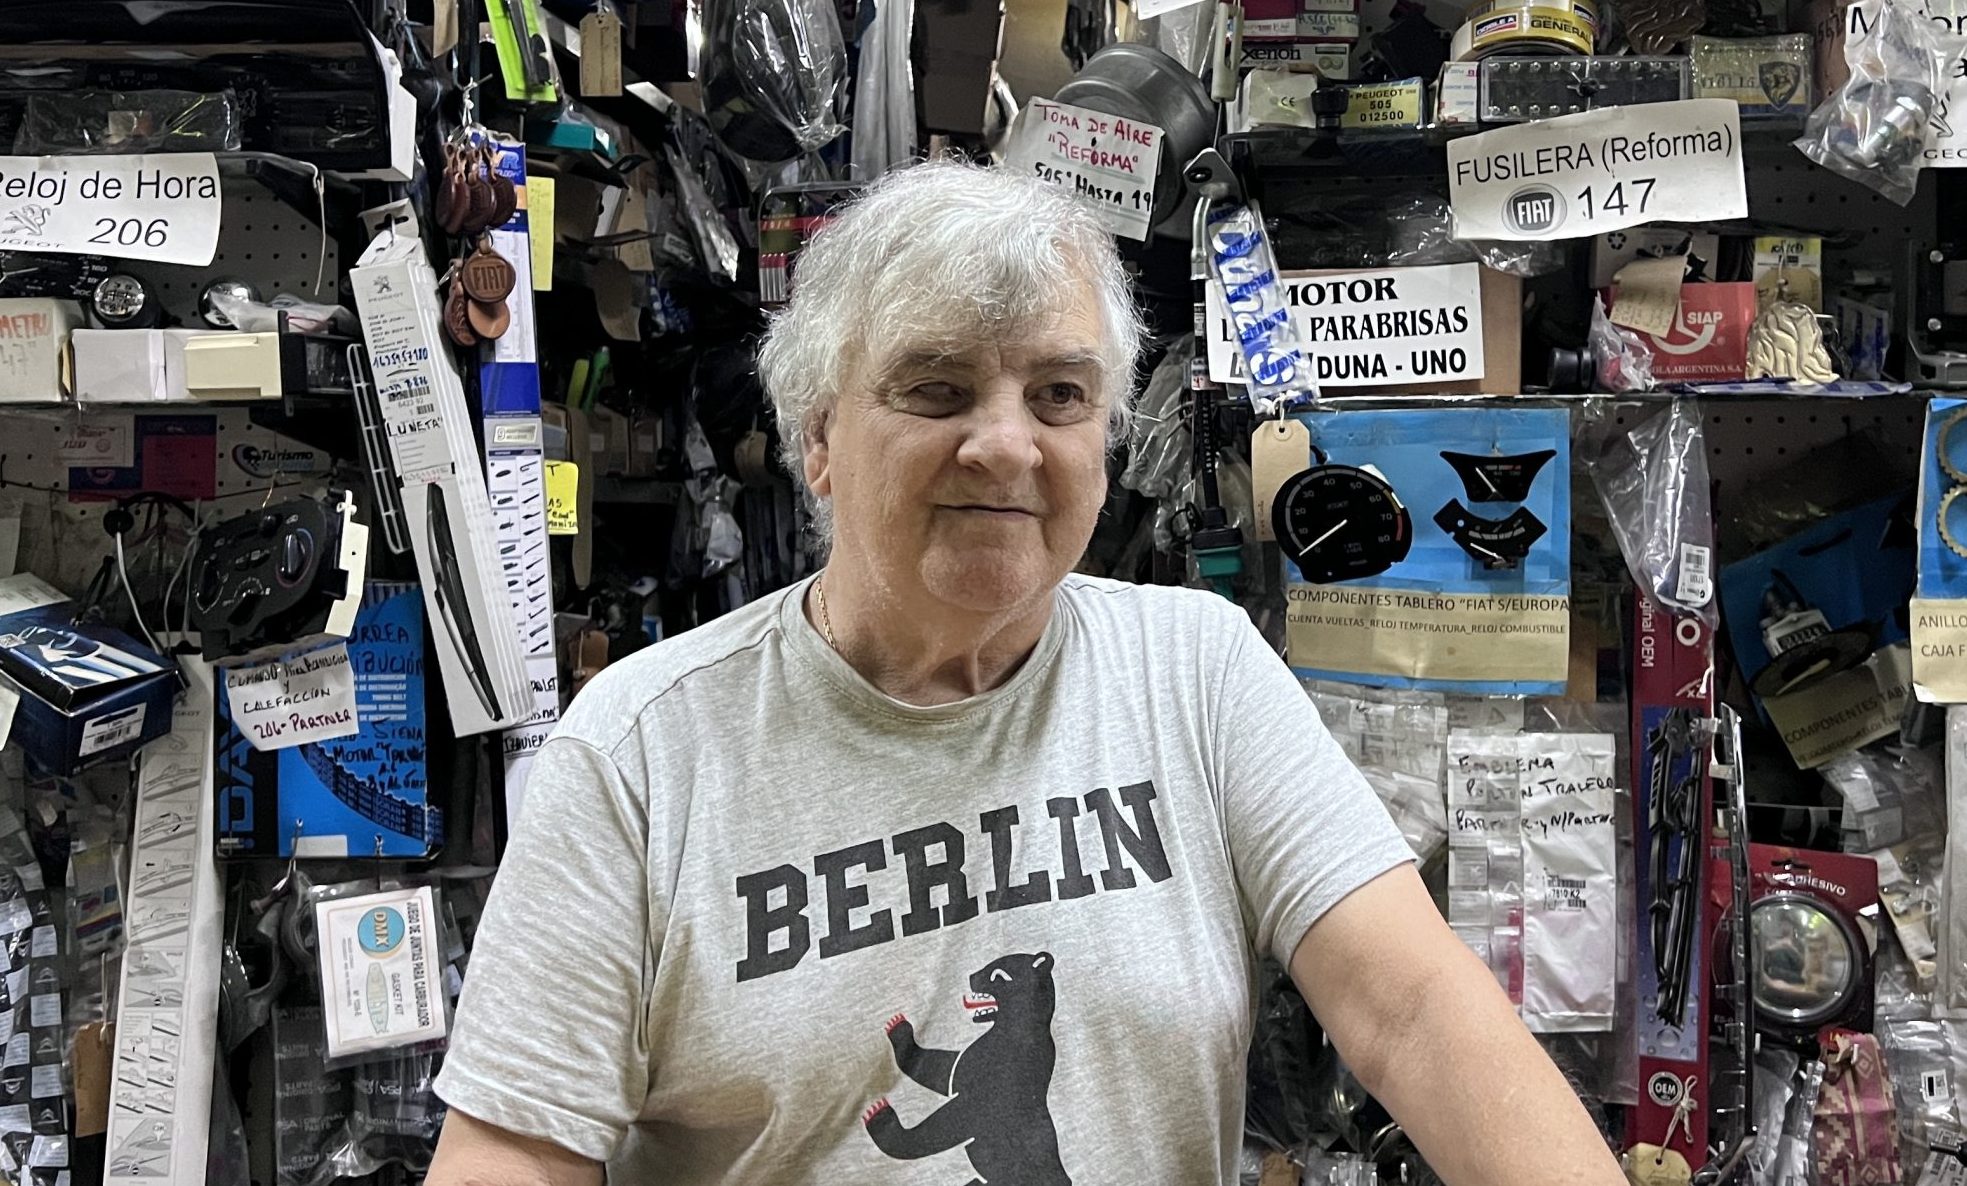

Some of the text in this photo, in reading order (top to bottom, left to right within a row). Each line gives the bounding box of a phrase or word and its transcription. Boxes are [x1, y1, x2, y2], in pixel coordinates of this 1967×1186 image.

[1356, 89, 1404, 100] PEUGEOT
[1370, 100, 1391, 110] 505
[1034, 104, 1153, 146] TOMA DE AIRE
[1360, 111, 1404, 122] 012500
[1456, 123, 1733, 186] FUSILERA (Reforma)
[0, 169, 216, 206] eloj de Hora
[1075, 174, 1123, 205] HASTA
[1516, 178, 1656, 225] FIAT 147
[88, 217, 169, 247] 206
[471, 264, 508, 291] FIAT
[1310, 306, 1469, 342] PARABRISAS
[1687, 311, 1723, 325] SIAP
[1317, 353, 1388, 380] DUNA
[1411, 347, 1467, 376] UNO
[1672, 364, 1726, 375] ARGENTINA
[1288, 589, 1392, 607] COMPONENTES
[1395, 595, 1455, 612] TABLERO
[1287, 614, 1323, 624] CUENTA
[1500, 623, 1566, 634] COMBUSTIBLE
[1641, 635, 1655, 668] OEM
[1921, 644, 1955, 658] CAJA
[736, 779, 1173, 984] BERLIN
[374, 911, 389, 947] DMX
[1655, 1082, 1676, 1096] OEM
